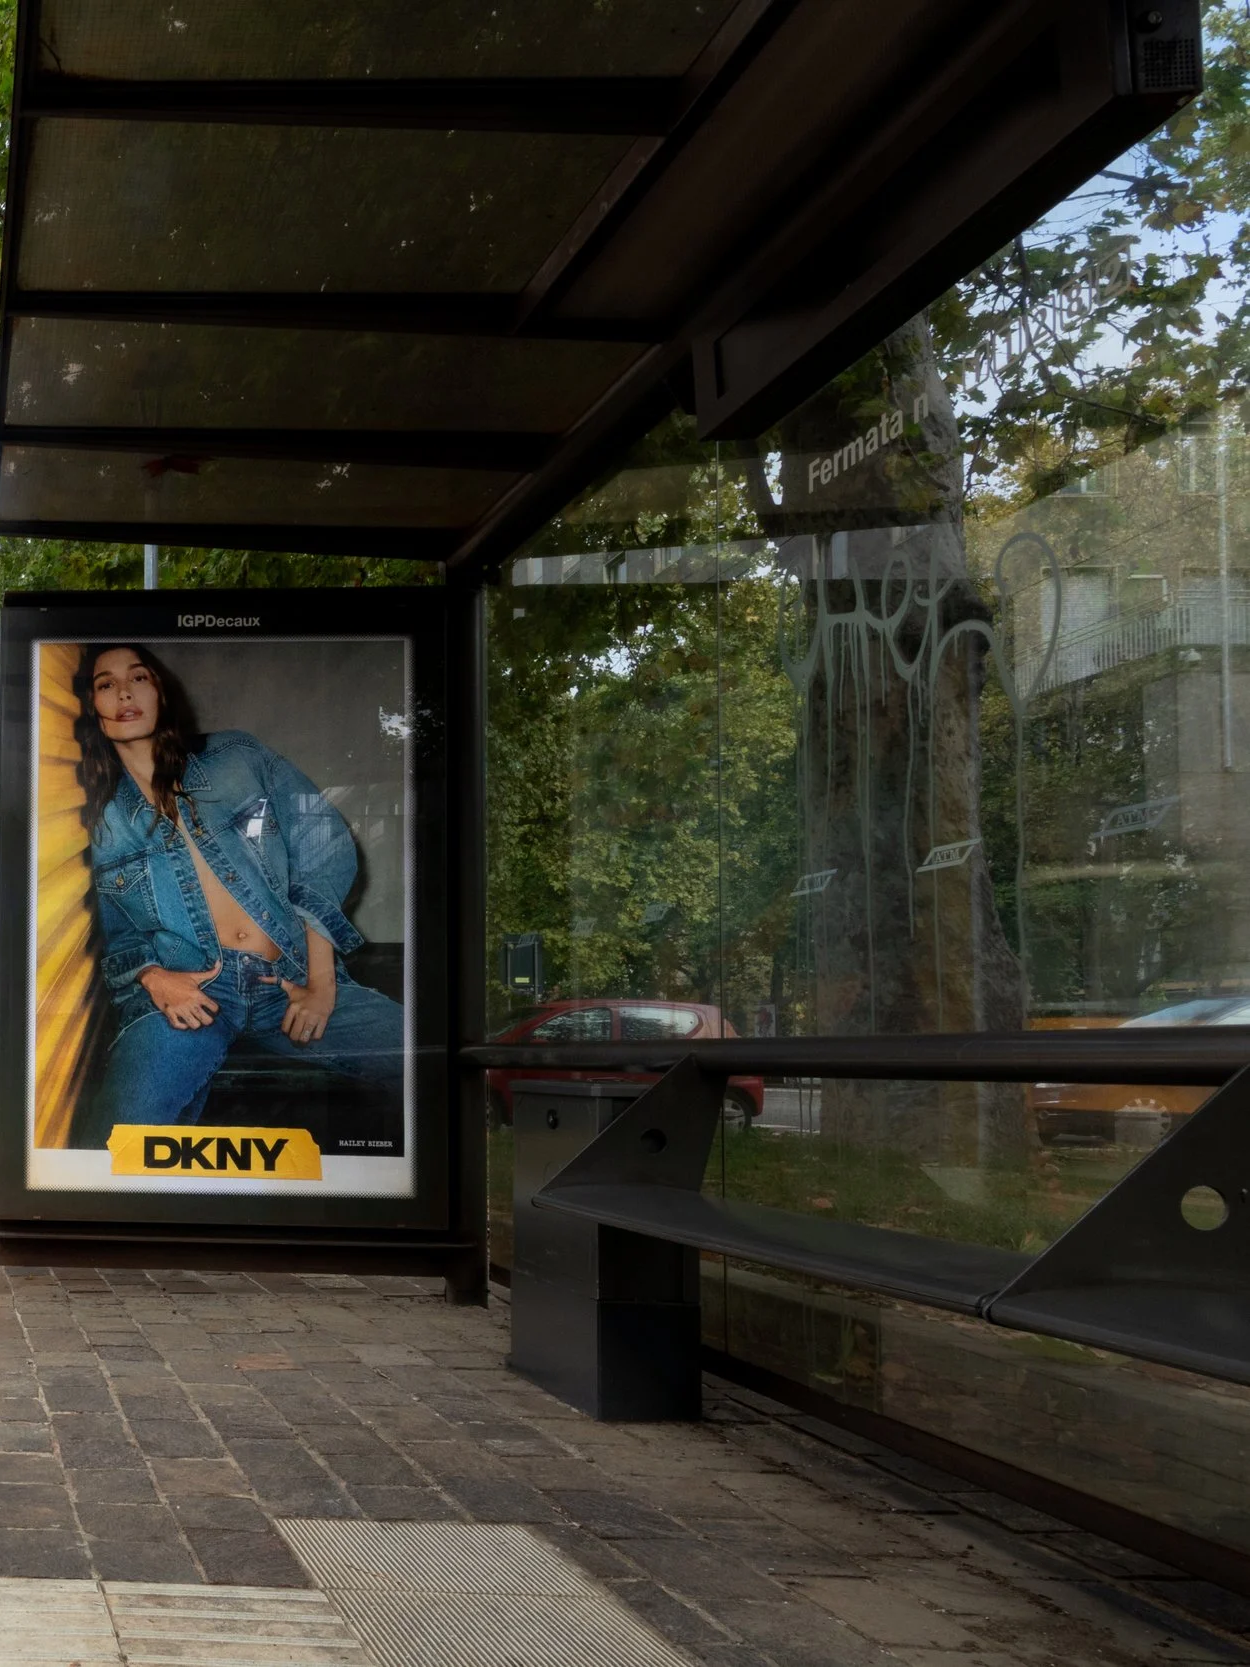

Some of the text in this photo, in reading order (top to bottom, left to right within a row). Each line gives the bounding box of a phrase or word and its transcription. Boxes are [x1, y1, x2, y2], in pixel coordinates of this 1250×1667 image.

[808, 410, 903, 495] Fermata
[177, 614, 261, 628] IGPDecaux
[933, 848, 960, 863] ATM
[338, 1139, 393, 1148] HAILEY BIEBER
[144, 1136, 289, 1171] DKNY
